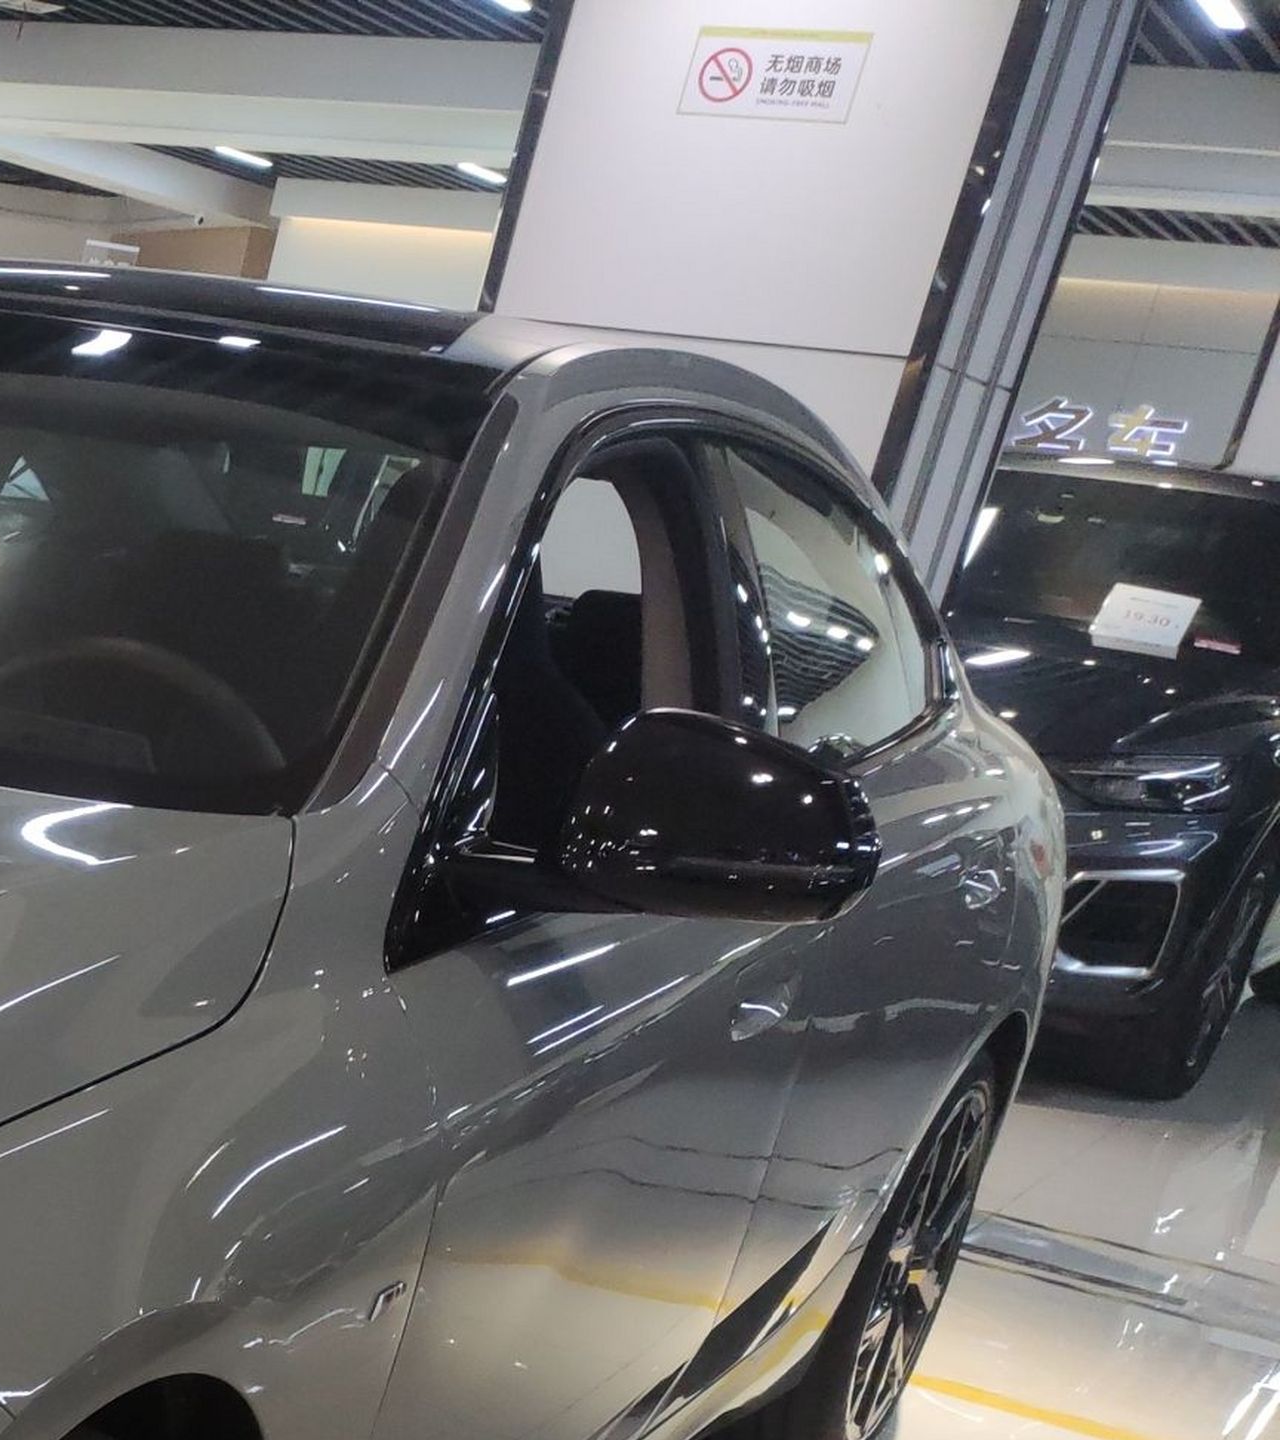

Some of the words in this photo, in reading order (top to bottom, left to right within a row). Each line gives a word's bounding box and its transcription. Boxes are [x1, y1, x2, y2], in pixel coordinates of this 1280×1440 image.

[765, 54, 843, 75] 无烟商场
[759, 76, 836, 98] 请勿吸烟
